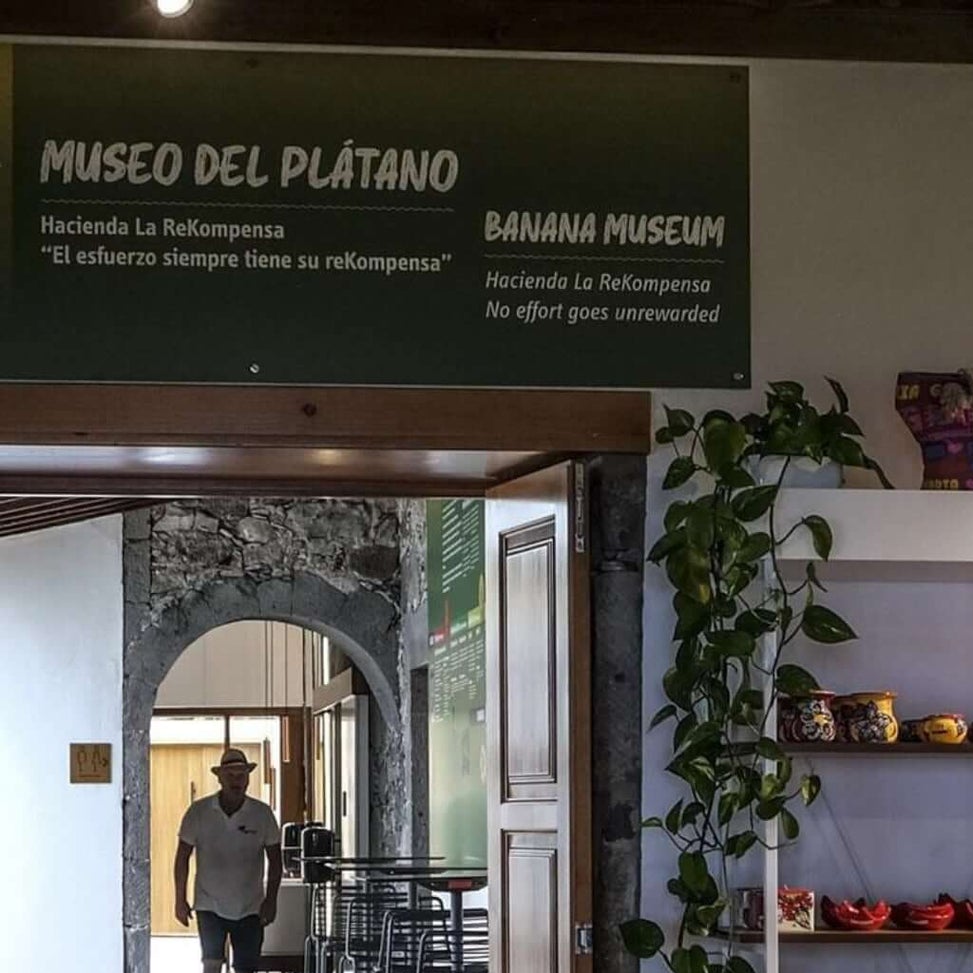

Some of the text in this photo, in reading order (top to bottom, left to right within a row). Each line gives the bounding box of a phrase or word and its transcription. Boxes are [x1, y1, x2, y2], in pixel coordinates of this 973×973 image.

[40, 138, 459, 193] MUSEO DEL PLÁTANO
[41, 215, 285, 243] Hacienda La ReKompensa
[484, 210, 726, 248] BANANA MUSEUM
[76, 246, 156, 266] esfuerzo
[162, 247, 239, 272] siempre
[244, 249, 292, 269] tiene
[297, 254, 320, 269] su
[485, 270, 712, 297] Hacienda La ReKompensa
[485, 300, 721, 325] No effort goes unrewarded
